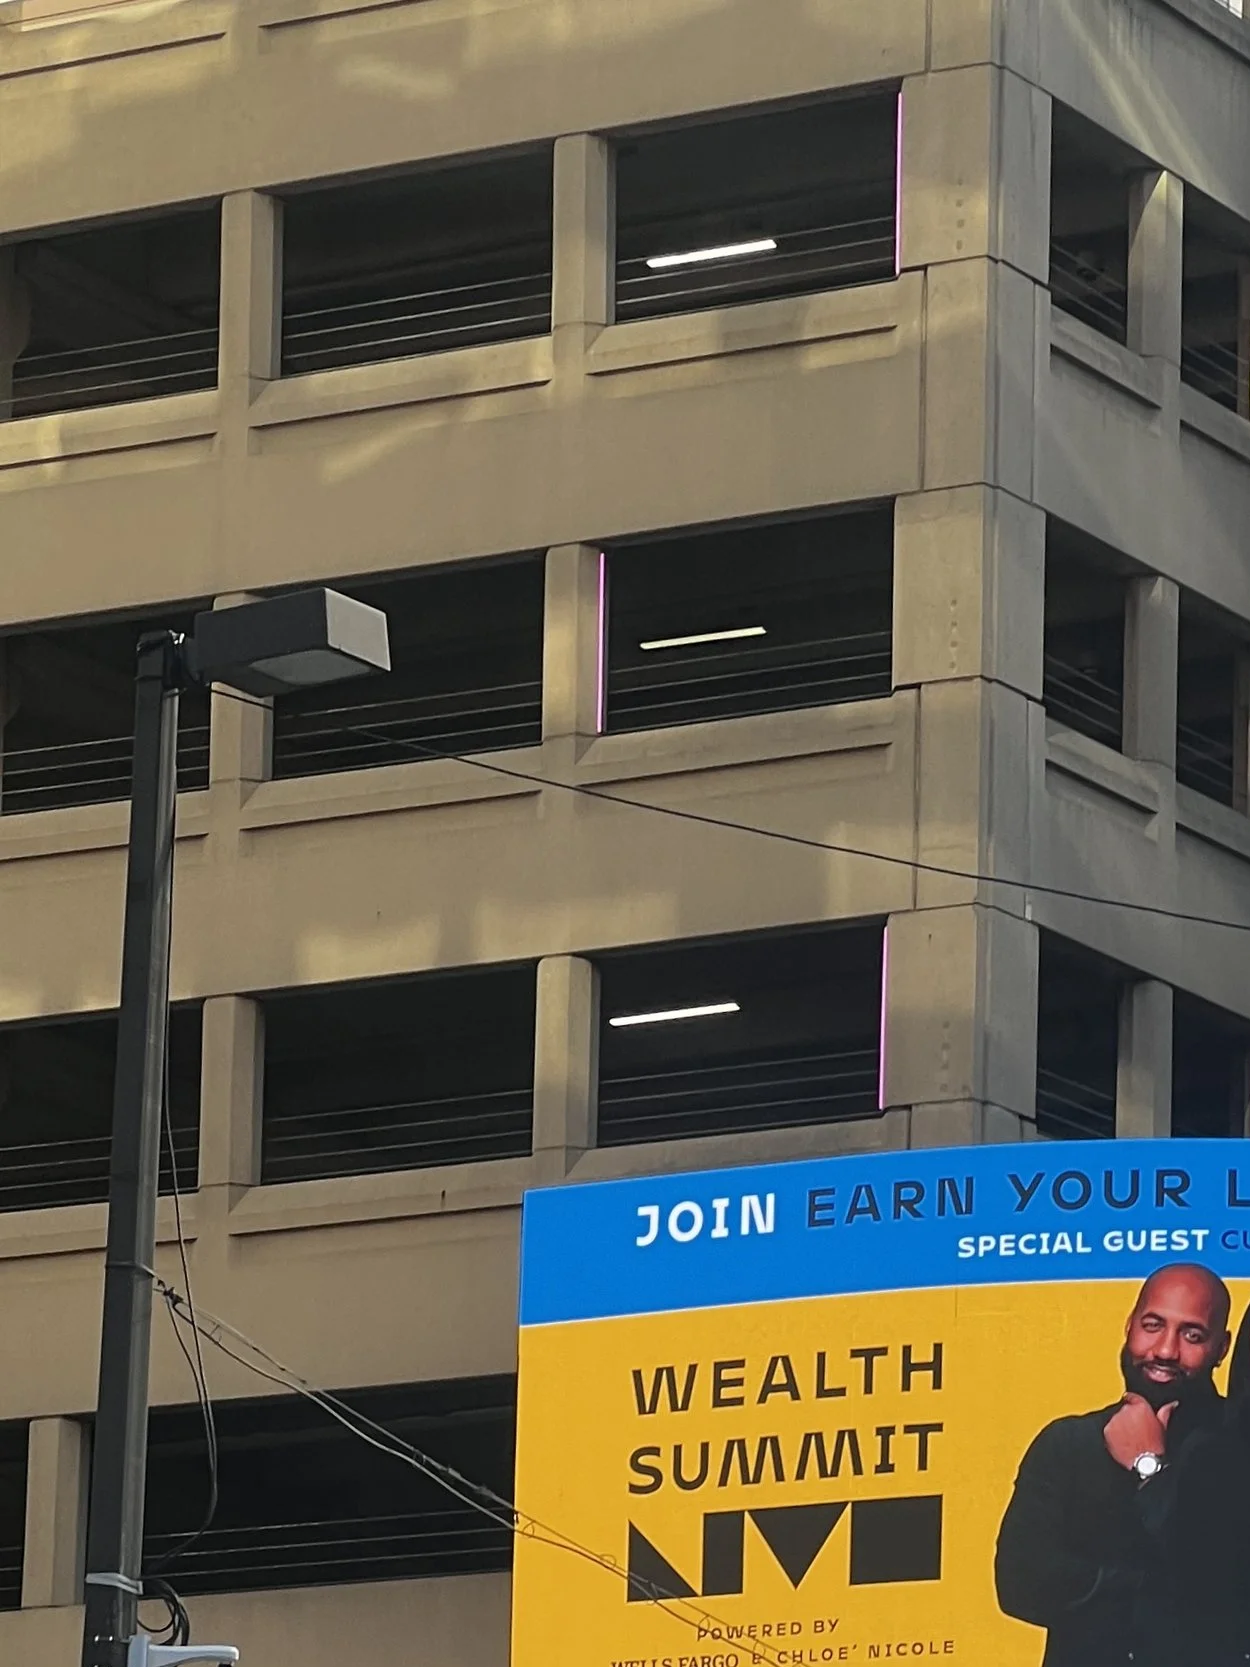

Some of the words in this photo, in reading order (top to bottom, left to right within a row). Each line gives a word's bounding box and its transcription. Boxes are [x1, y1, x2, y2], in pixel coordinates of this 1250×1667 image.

[635, 1192, 776, 1247] JOIN
[807, 1175, 975, 1229] EARN
[1008, 1168, 1193, 1213] YOUR
[957, 1231, 1092, 1258] SPECIAL
[1103, 1229, 1209, 1253] GUEST
[632, 1341, 943, 1416] WEALTH
[627, 1422, 943, 1495] SUMMIT
[698, 1621, 802, 1642] POWERED
[814, 1619, 839, 1633] BY
[869, 1640, 955, 1659] NICOLE
